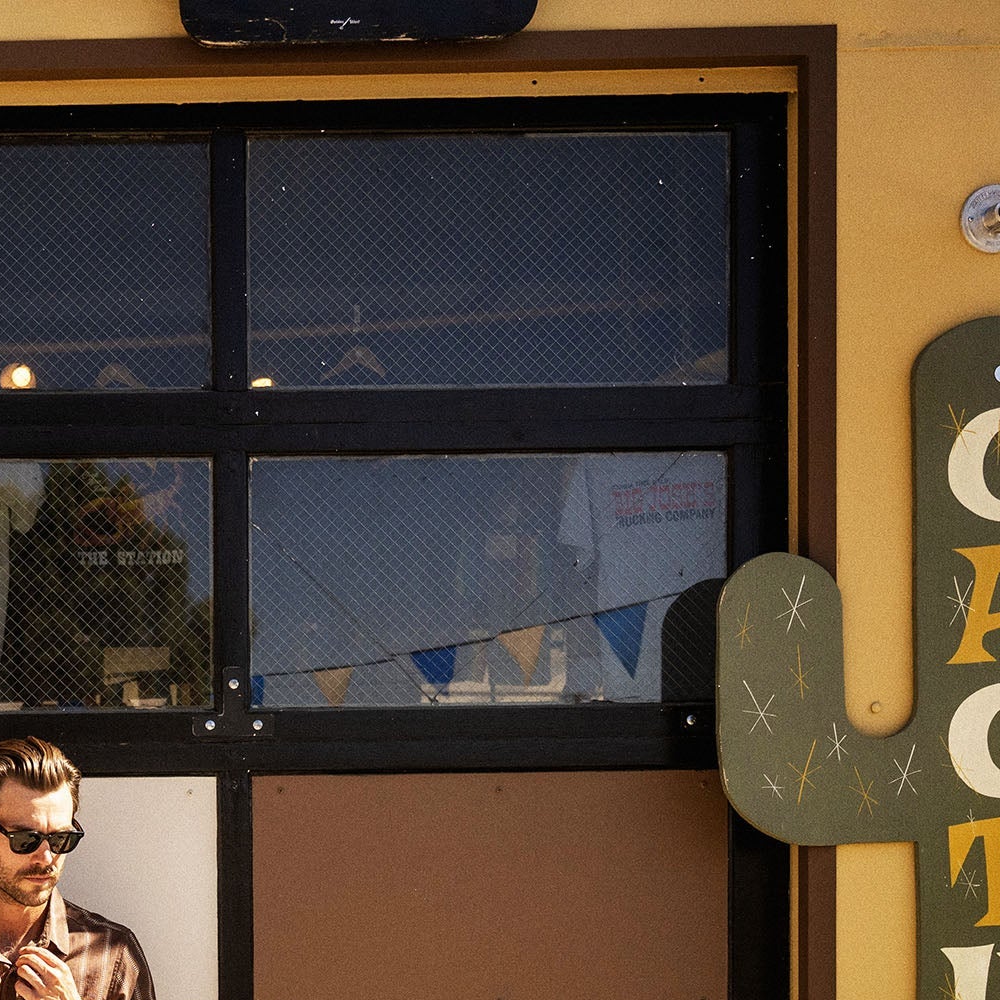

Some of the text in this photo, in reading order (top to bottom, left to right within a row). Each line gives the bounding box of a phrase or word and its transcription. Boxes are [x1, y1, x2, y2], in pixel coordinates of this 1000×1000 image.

[665, 507, 716, 522] COMPANY
[77, 548, 184, 566] THE STATION
